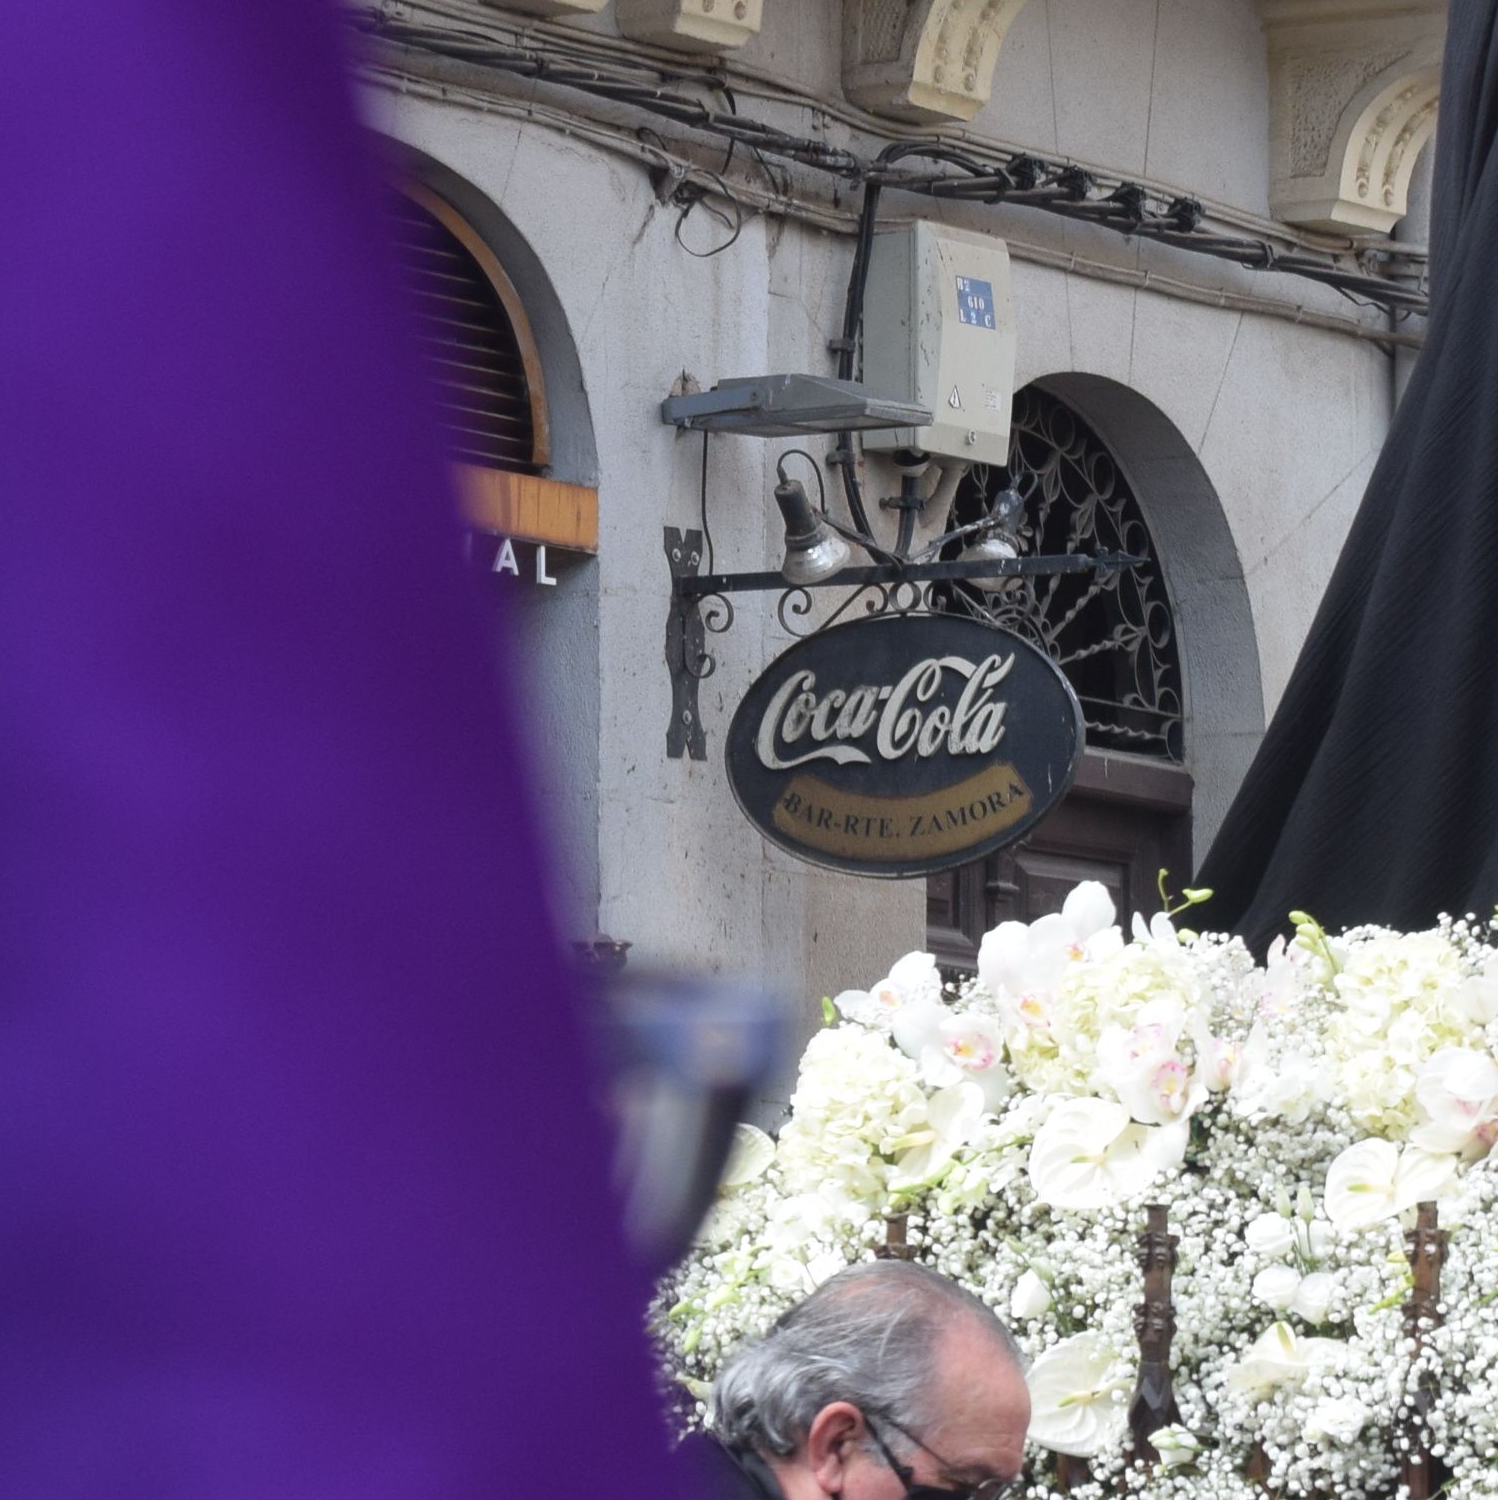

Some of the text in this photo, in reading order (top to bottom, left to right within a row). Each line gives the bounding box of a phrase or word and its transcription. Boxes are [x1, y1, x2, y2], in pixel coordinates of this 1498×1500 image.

[755, 652, 1016, 771] Coca-Cola
[782, 781, 1025, 839] BAR-RTE. ZAMORA
